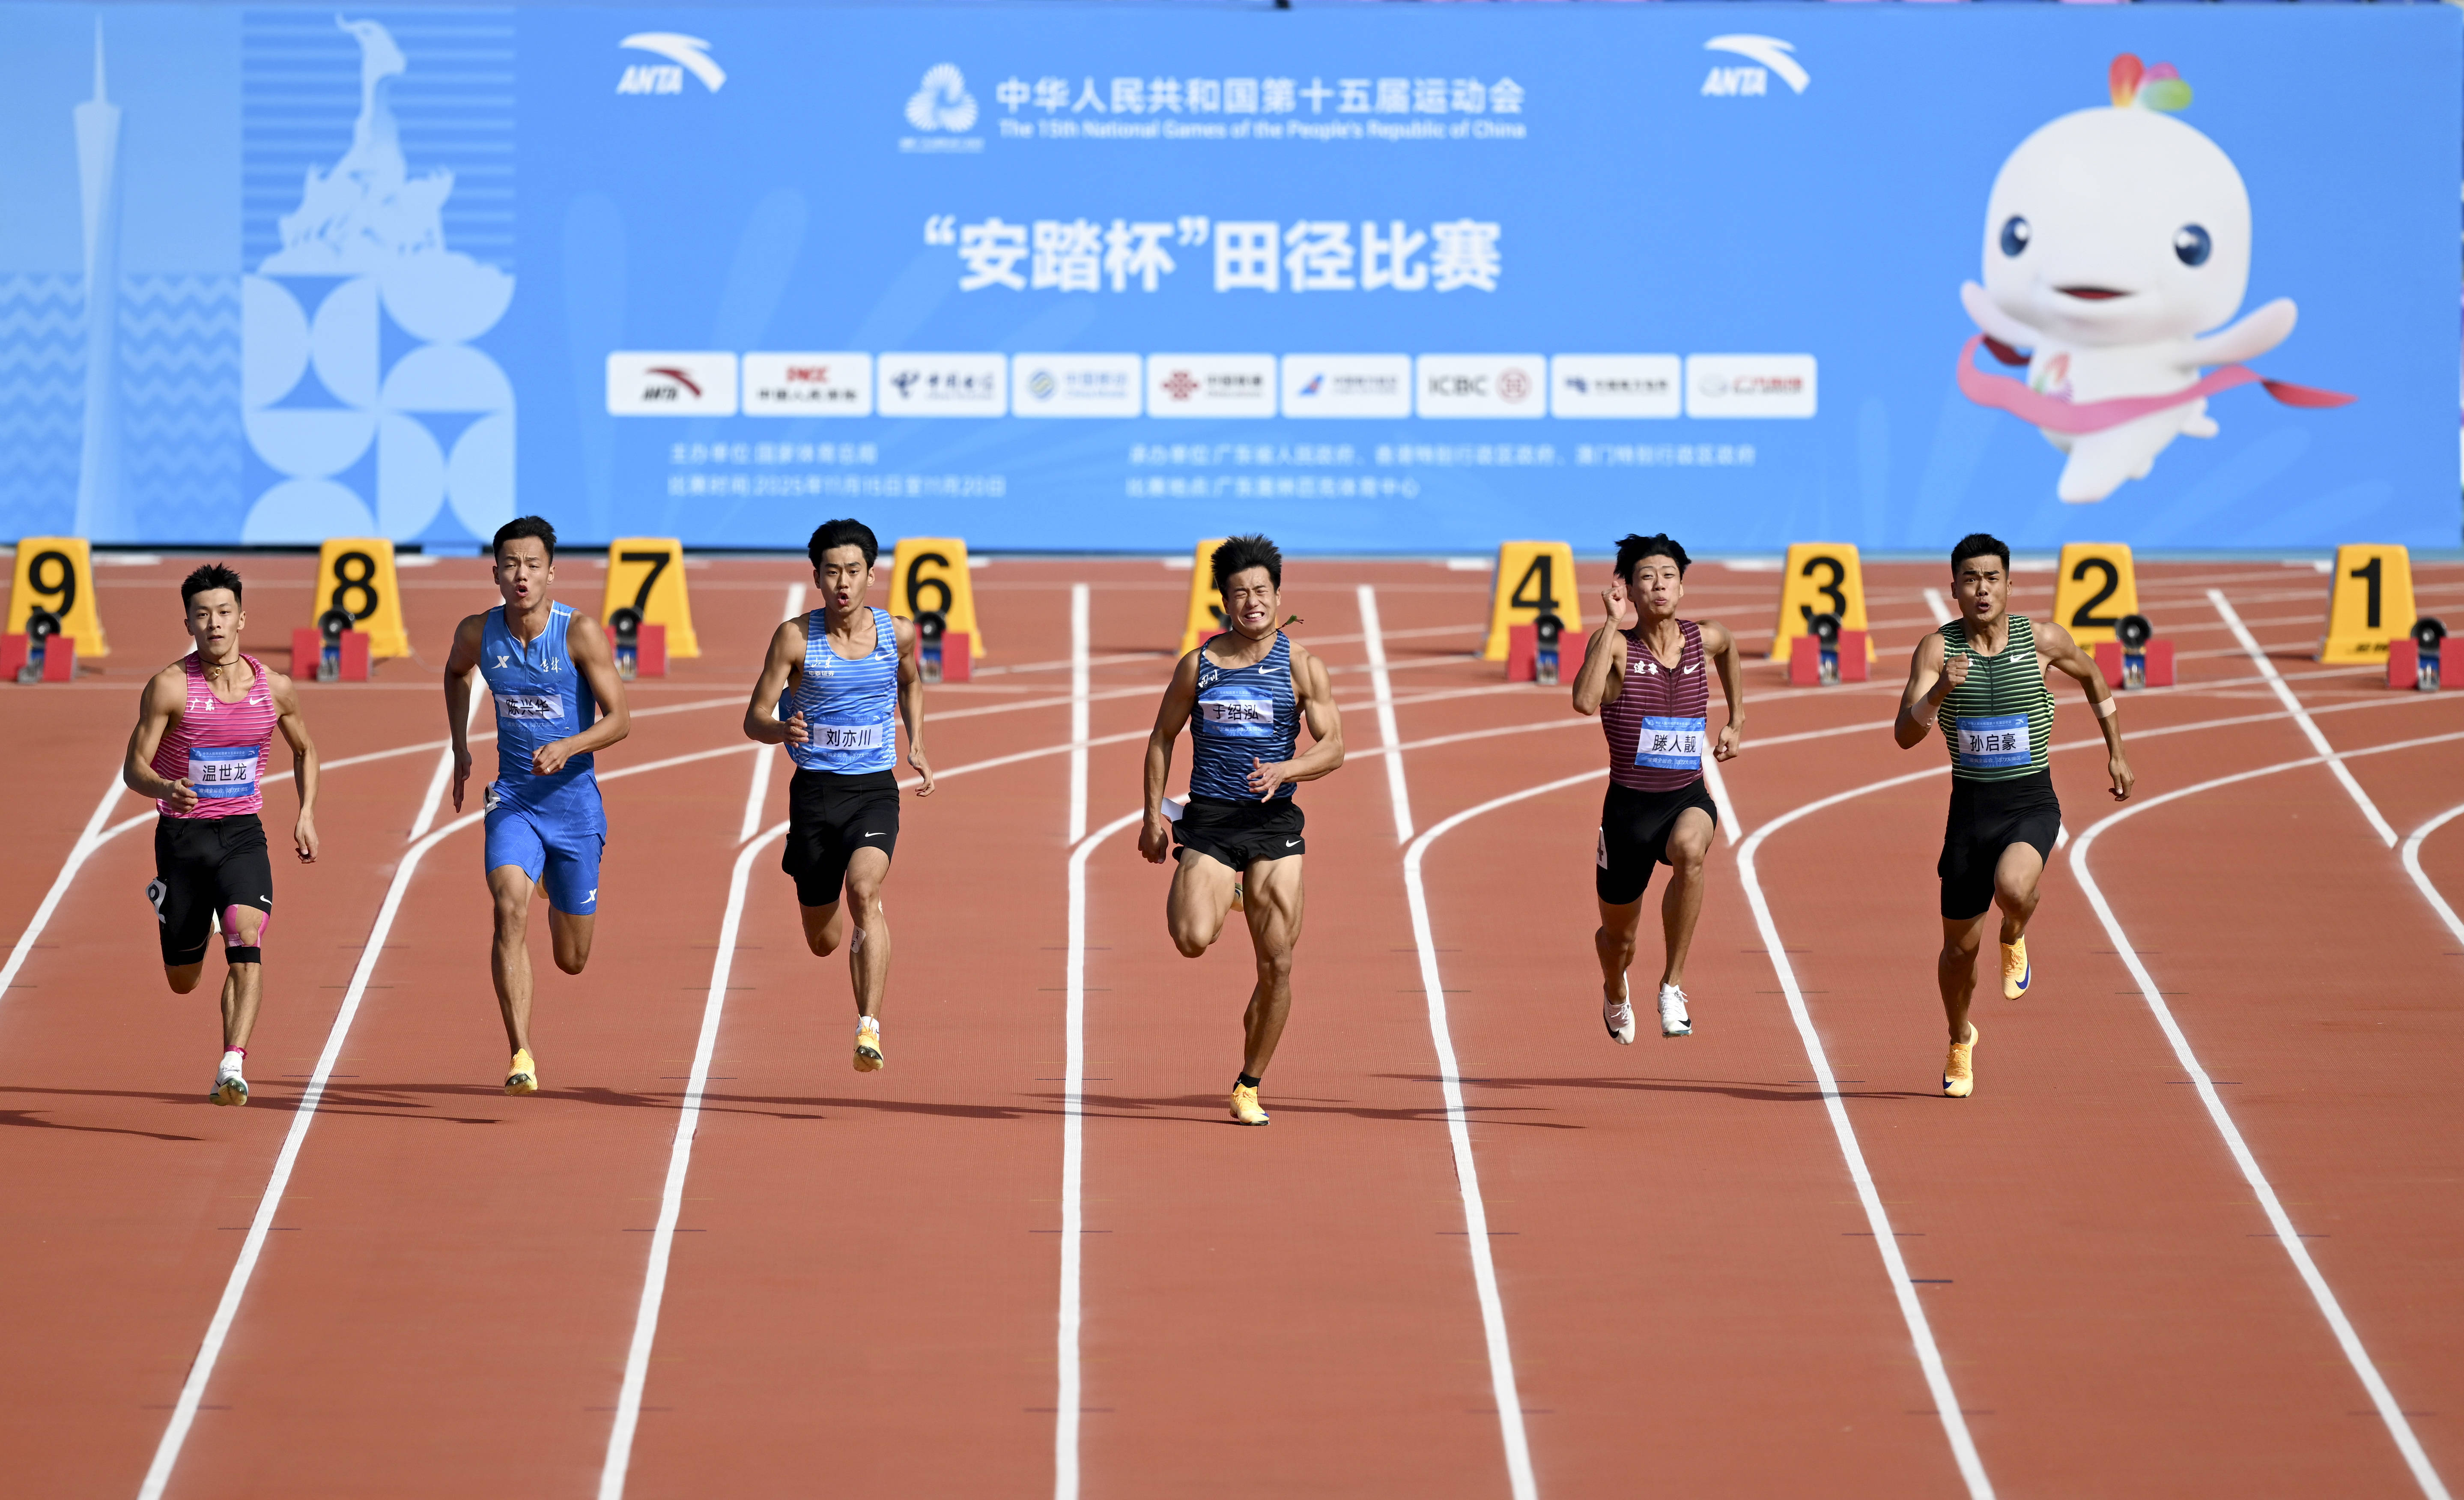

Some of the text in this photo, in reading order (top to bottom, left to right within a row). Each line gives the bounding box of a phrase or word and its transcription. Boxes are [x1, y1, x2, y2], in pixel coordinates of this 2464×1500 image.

[615, 64, 683, 95] ANTA
[996, 77, 1525, 114] 中华人民共和国第十五届运动会
[1700, 66, 1768, 97] ANTA
[924, 215, 1501, 293] “安踏杯”田径比赛
[28, 551, 76, 617] 9
[331, 551, 378, 619] 8
[621, 552, 670, 613] 7
[907, 553, 952, 615] 6
[1511, 555, 1559, 612] 4
[1800, 556, 1847, 621] 3
[2071, 557, 2119, 627] 2
[2351, 557, 2381, 628] 1
[540, 656, 562, 673] 吉林
[190, 698, 215, 711] 广东
[506, 699, 550, 716] 陈兴华
[1212, 703, 1259, 720] 于绍泓
[826, 729, 871, 747] 刘亦川
[1652, 734, 1696, 753] 滕人靓
[1969, 733, 2017, 752] 孙启豪
[202, 762, 247, 782] 温世龙
